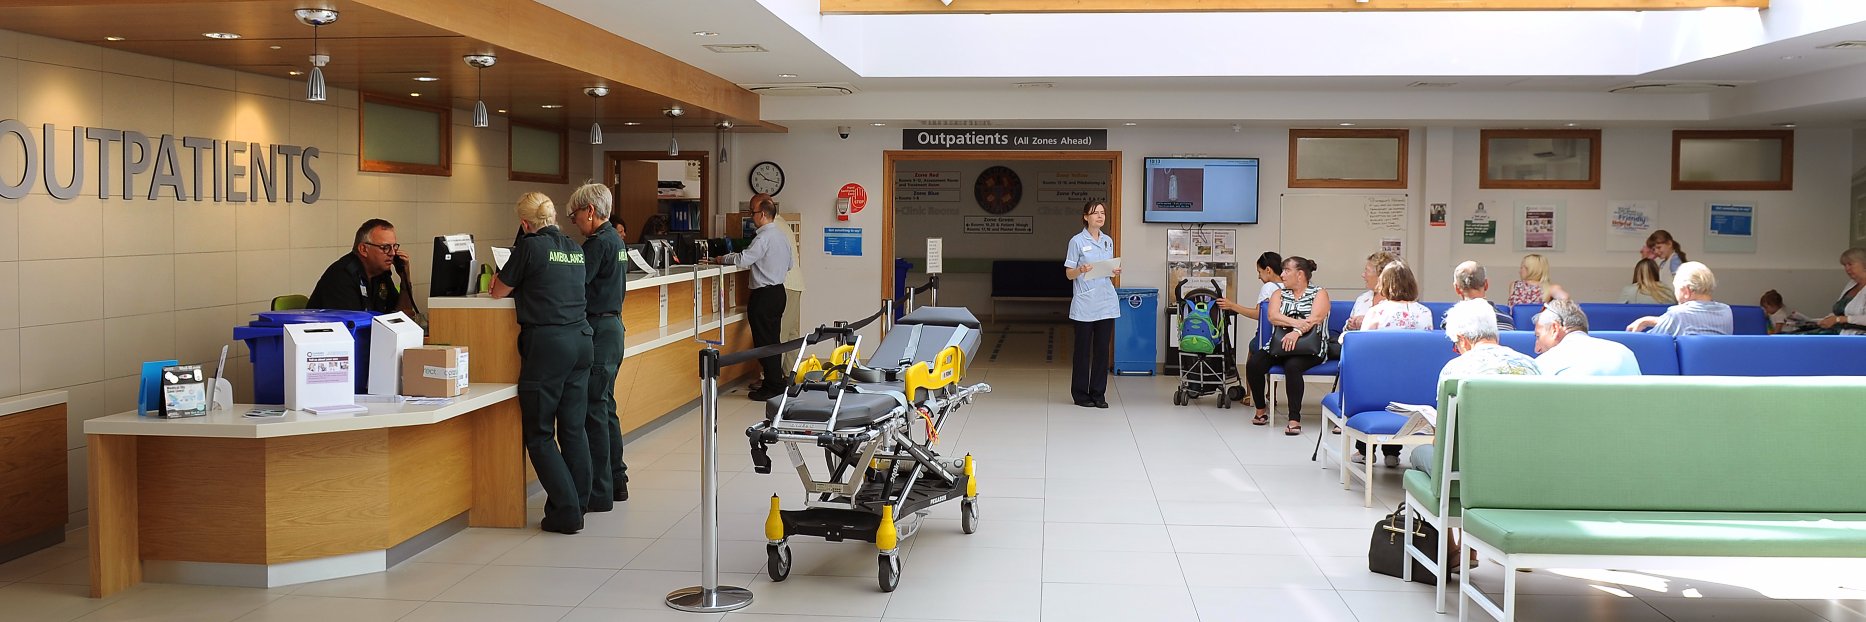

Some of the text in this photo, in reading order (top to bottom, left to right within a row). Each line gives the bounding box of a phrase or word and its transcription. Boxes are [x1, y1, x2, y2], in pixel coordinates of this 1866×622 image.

[917, 131, 1092, 148] Outpatients (All Zones Ahead)
[0, 118, 322, 205] OUTPATIENTS
[1618, 214, 1646, 224] Friendly
[549, 250, 585, 264] AMBULANCE
